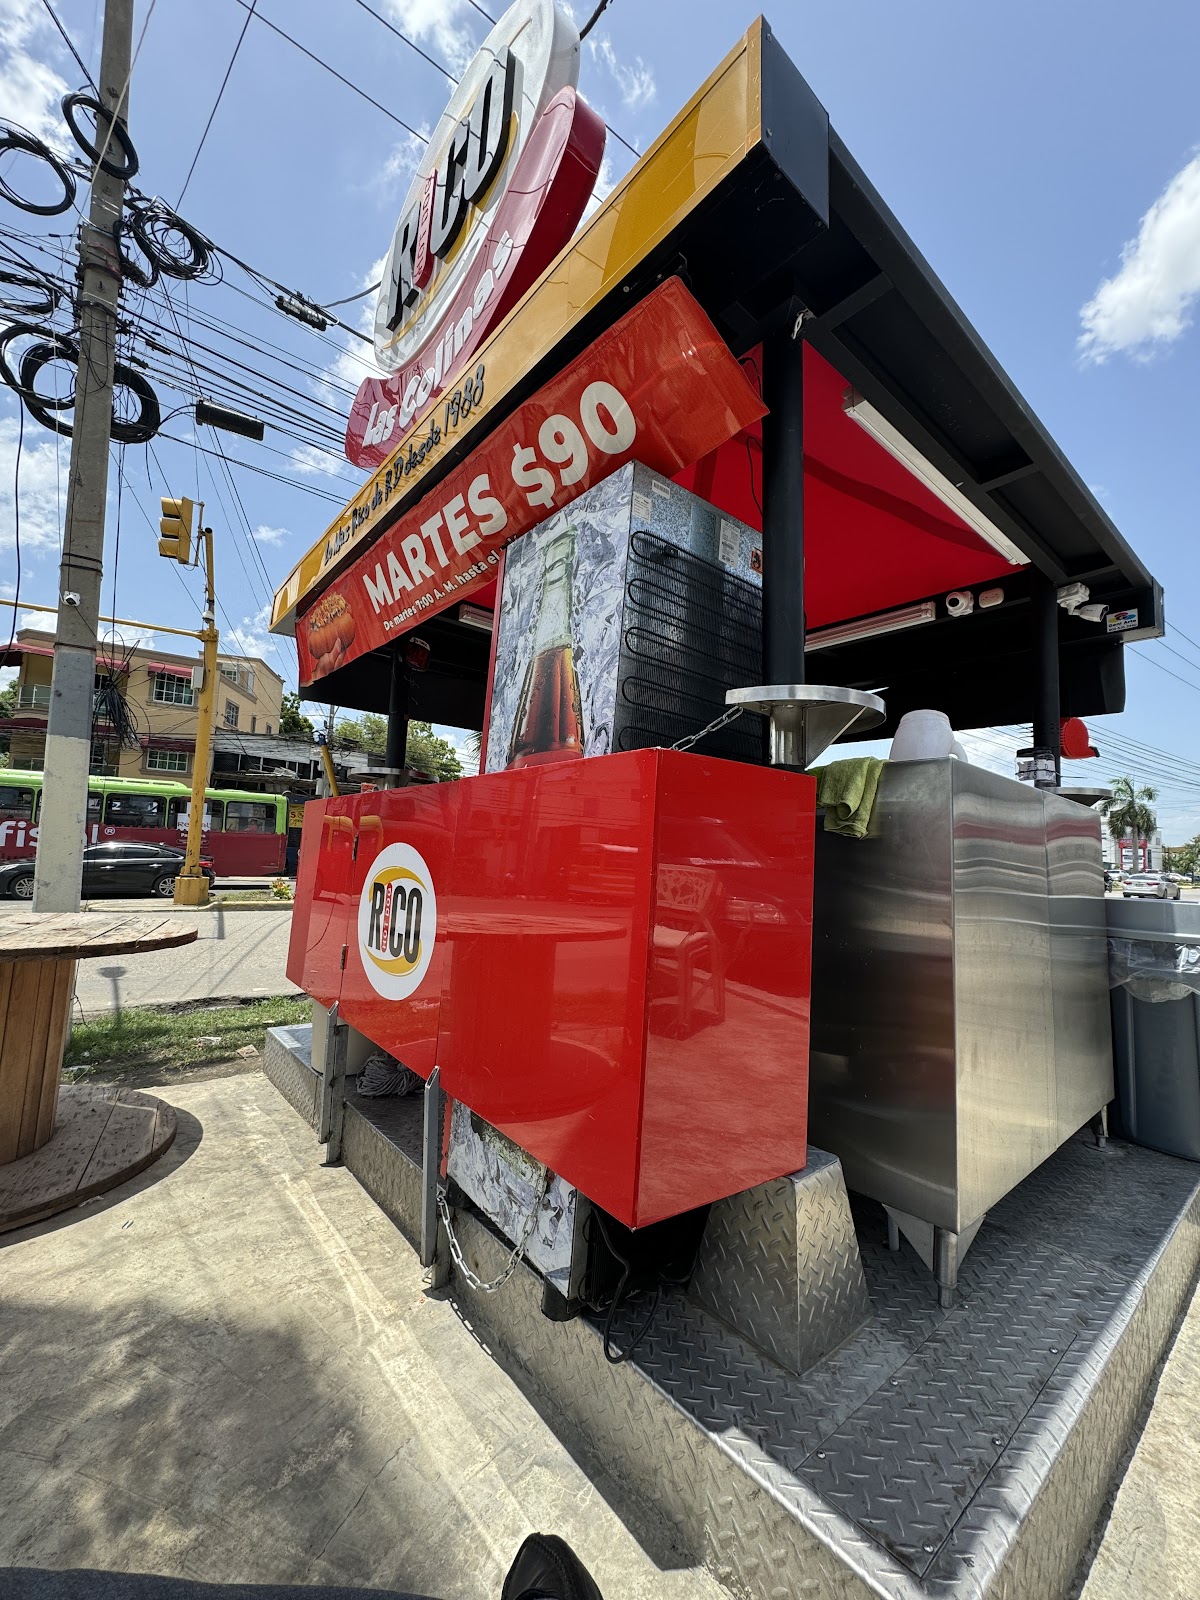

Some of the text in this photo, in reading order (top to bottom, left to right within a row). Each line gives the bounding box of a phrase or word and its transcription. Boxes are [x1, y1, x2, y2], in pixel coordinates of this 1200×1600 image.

[362, 230, 514, 447] Las Colinas
[444, 363, 485, 436] 1988
[362, 381, 636, 614] MARTES $90
[383, 620, 394, 631] De
[394, 606, 417, 626] martes
[415, 593, 435, 611] 7:00
[454, 561, 489, 585] hasta
[487, 549, 500, 565] el
[367, 881, 423, 964] RICO
[381, 921, 389, 949] HOT
